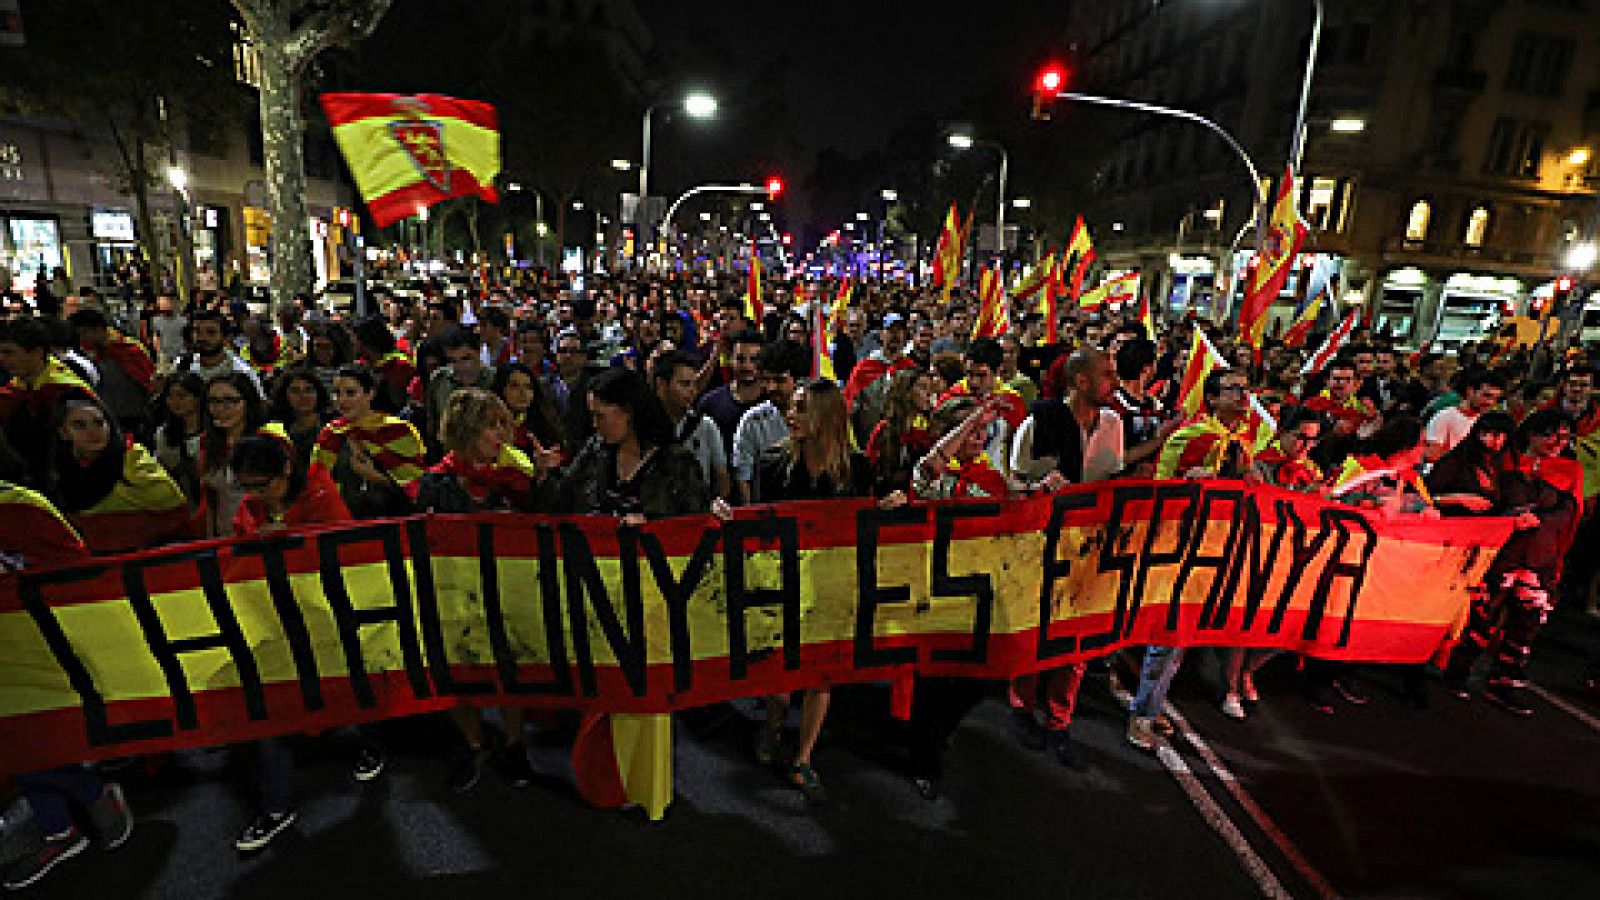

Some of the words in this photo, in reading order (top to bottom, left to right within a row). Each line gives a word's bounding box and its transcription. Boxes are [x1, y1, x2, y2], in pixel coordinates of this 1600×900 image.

[19, 516, 799, 747] CATALUNYA
[854, 503, 1001, 669] ES
[1037, 484, 1377, 660] ESPANYA
